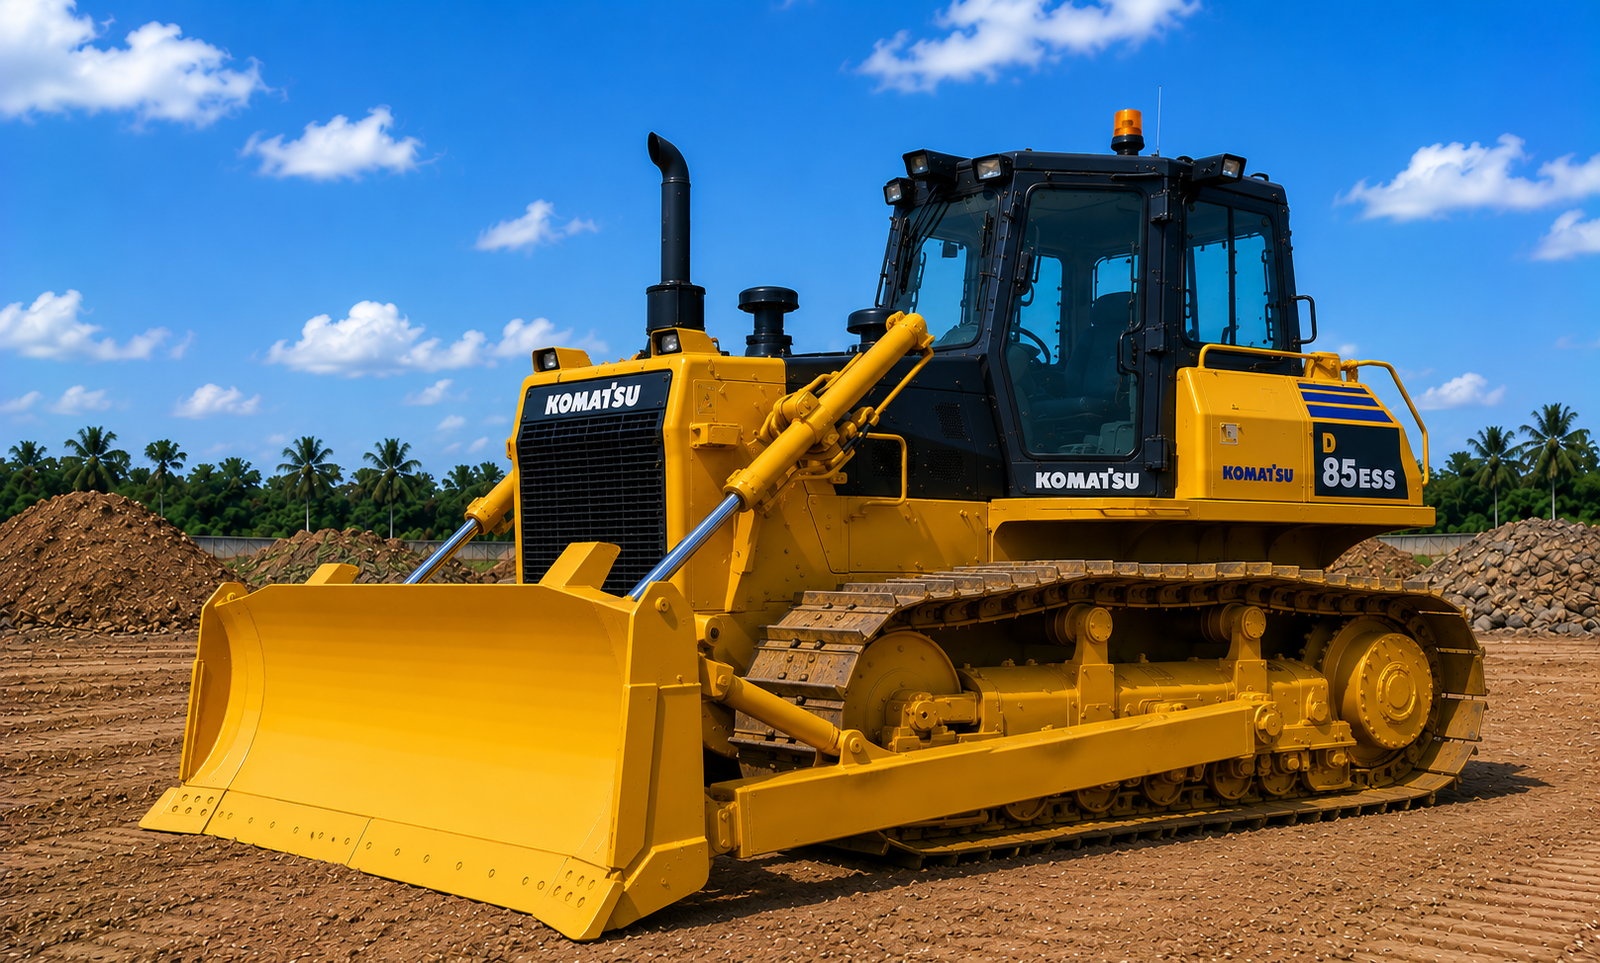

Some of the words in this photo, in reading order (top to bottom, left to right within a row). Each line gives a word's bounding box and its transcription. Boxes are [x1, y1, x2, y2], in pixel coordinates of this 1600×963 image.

[545, 382, 641, 415] KOMATSU
[1322, 433, 1336, 453] D
[1035, 467, 1139, 489] KOMATSU
[1222, 464, 1293, 483] KOMATSU
[1322, 457, 1396, 490] 85ESS
